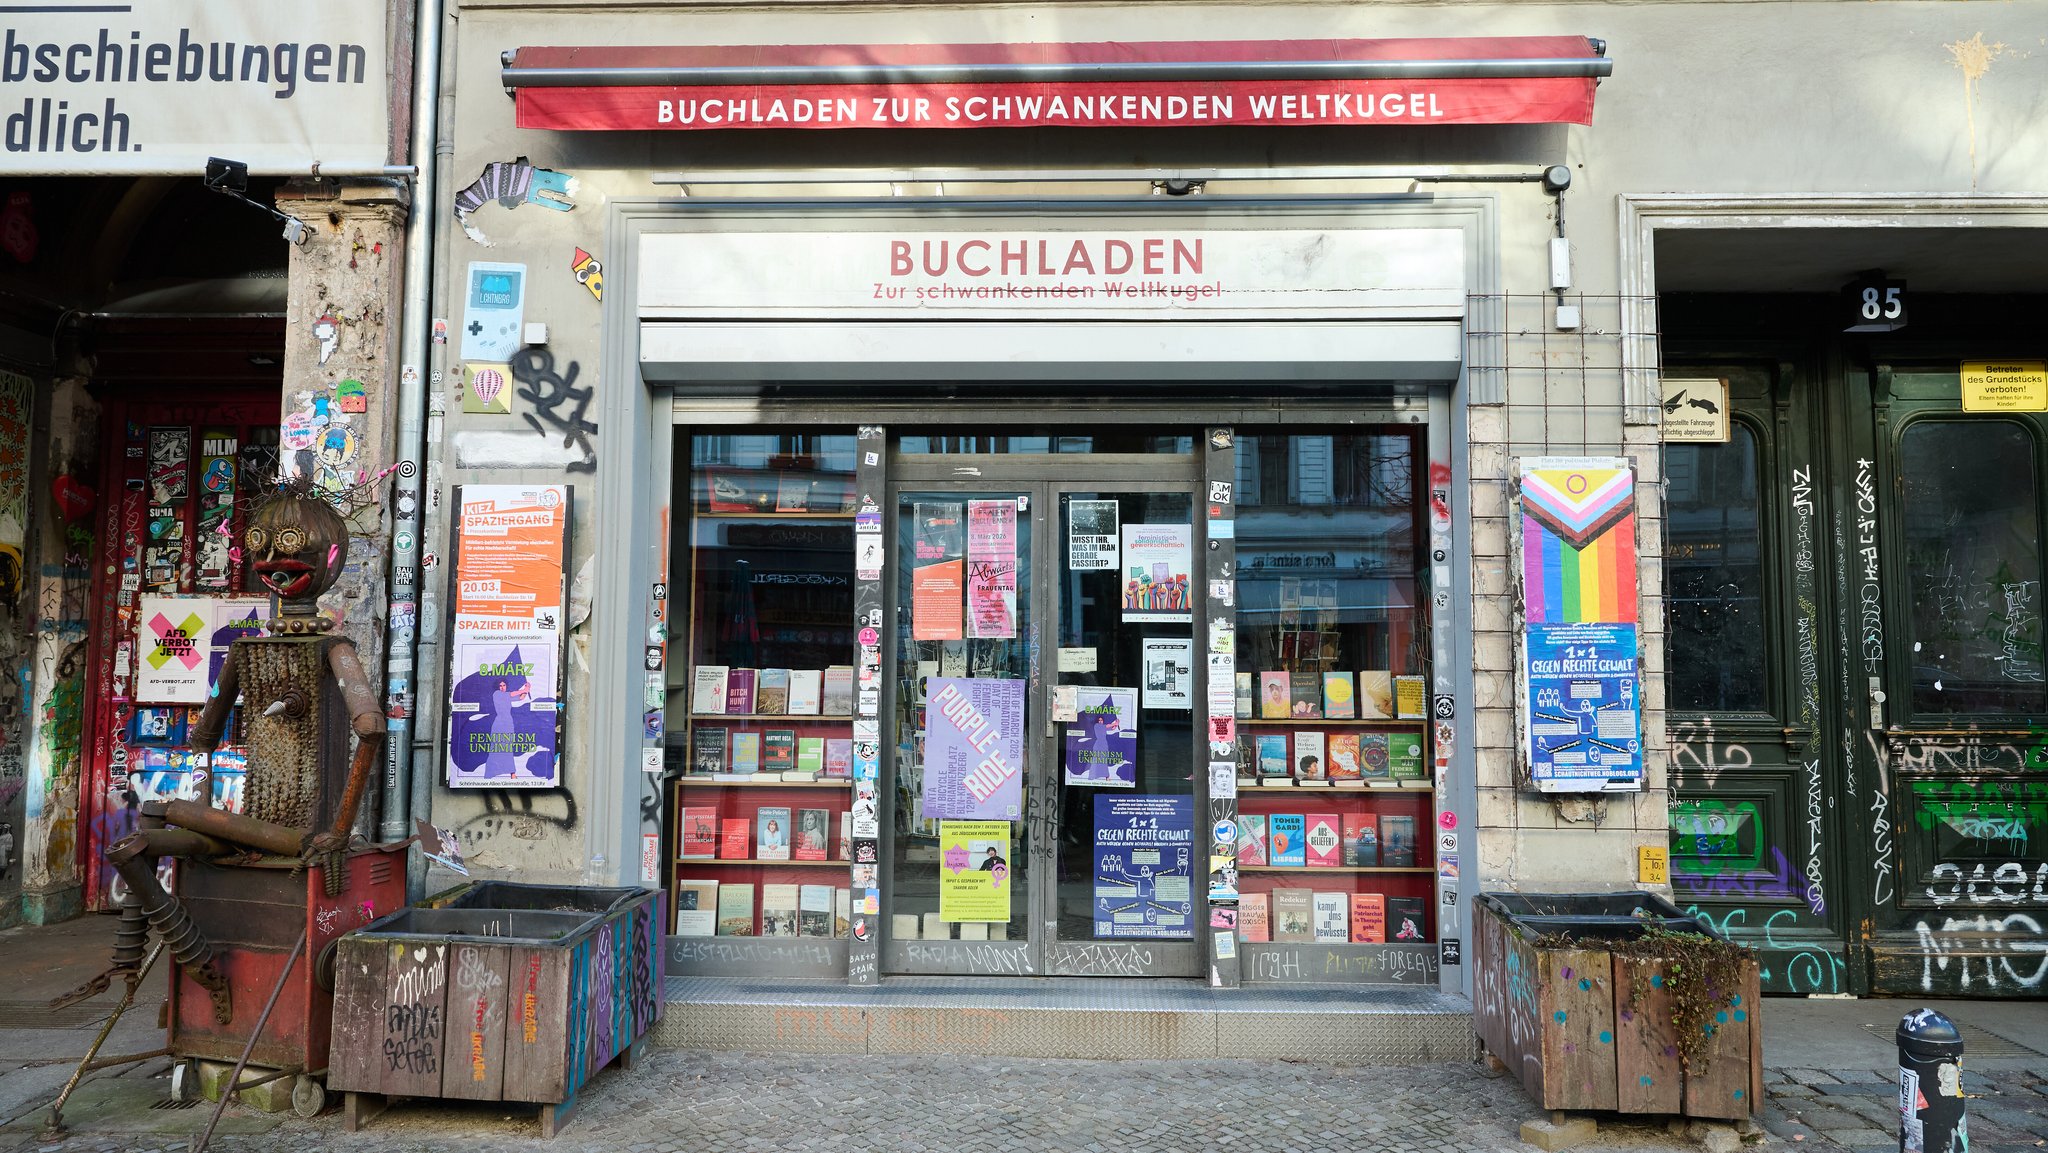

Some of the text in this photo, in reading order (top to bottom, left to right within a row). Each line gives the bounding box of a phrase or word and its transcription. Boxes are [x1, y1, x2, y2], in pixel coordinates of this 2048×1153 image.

[3, 28, 366, 98] bschiebungen
[657, 92, 1444, 125] BUCHLADEN ZUR SCHWANKENDEN WELTKUGEL
[5, 97, 142, 153] dlich.
[889, 238, 1205, 276] BUCHLADEN
[873, 280, 1223, 302] Zur schwankenden Weltkugel
[1861, 287, 1902, 319] 85
[1985, 365, 2023, 373] Betreten
[1986, 375, 2042, 383] Grundstücks
[1690, 419, 1715, 427] Fahrzeuge
[1684, 429, 1716, 437] abgeschleppt
[203, 439, 238, 456] MLM
[1212, 492, 1229, 502] OK
[149, 507, 173, 518] SUMA
[465, 502, 493, 515] KIEZ
[466, 514, 550, 527] SPAZIERGANG
[1071, 536, 1095, 544] WISST
[1071, 544, 1116, 552] WAS IM IRAN
[1071, 552, 1098, 560] GERADE
[1071, 559, 1109, 568] PASSIERT?
[968, 561, 1015, 584] Abwärts!
[463, 582, 499, 593] 20.03.
[389, 613, 416, 629] CATS
[458, 620, 531, 630] SPAZIER MIT!
[165, 629, 187, 637] AFD
[154, 638, 197, 647] VERBOT
[159, 647, 192, 657] JETZT
[479, 661, 535, 677] 8.MÄRZ
[1532, 658, 1634, 674] GEGEN RECHTE GEWALT
[730, 688, 748, 696] BITCH
[972, 683, 981, 709] FIGHTS
[991, 684, 1001, 708] DAY OF
[729, 697, 746, 705] HUNT
[981, 683, 991, 718] FEMINIST
[1000, 683, 1011, 741] INTERNATIONAL
[1085, 704, 1122, 715] 8.MÄRZ
[931, 682, 1001, 754] PURPLE
[1009, 684, 1021, 759] 8TH OF MARCH 2026
[469, 733, 536, 743] FEMINISM
[469, 743, 537, 753] UNLIMITED
[1078, 750, 1123, 758] FEMINISM
[1078, 756, 1124, 765] UNLIMITED
[962, 748, 1016, 804] RIDE
[1554, 770, 1639, 778] SCHAUTNICHTWEG.NOBLOGS.ORG
[938, 770, 947, 801] BICYCLE
[946, 745, 958, 815] MARIANNENPLATZ
[956, 751, 967, 815] BLN-KREUZBERG
[1098, 828, 1190, 841] GEGEN RECHTE GEWALT
[1317, 827, 1329, 837] AUS-
[1310, 836, 1334, 847] GELIEFERT
[1317, 901, 1337, 914] kampf
[1360, 917, 1382, 925] Therapie
[1315, 927, 1347, 938] bewusste
